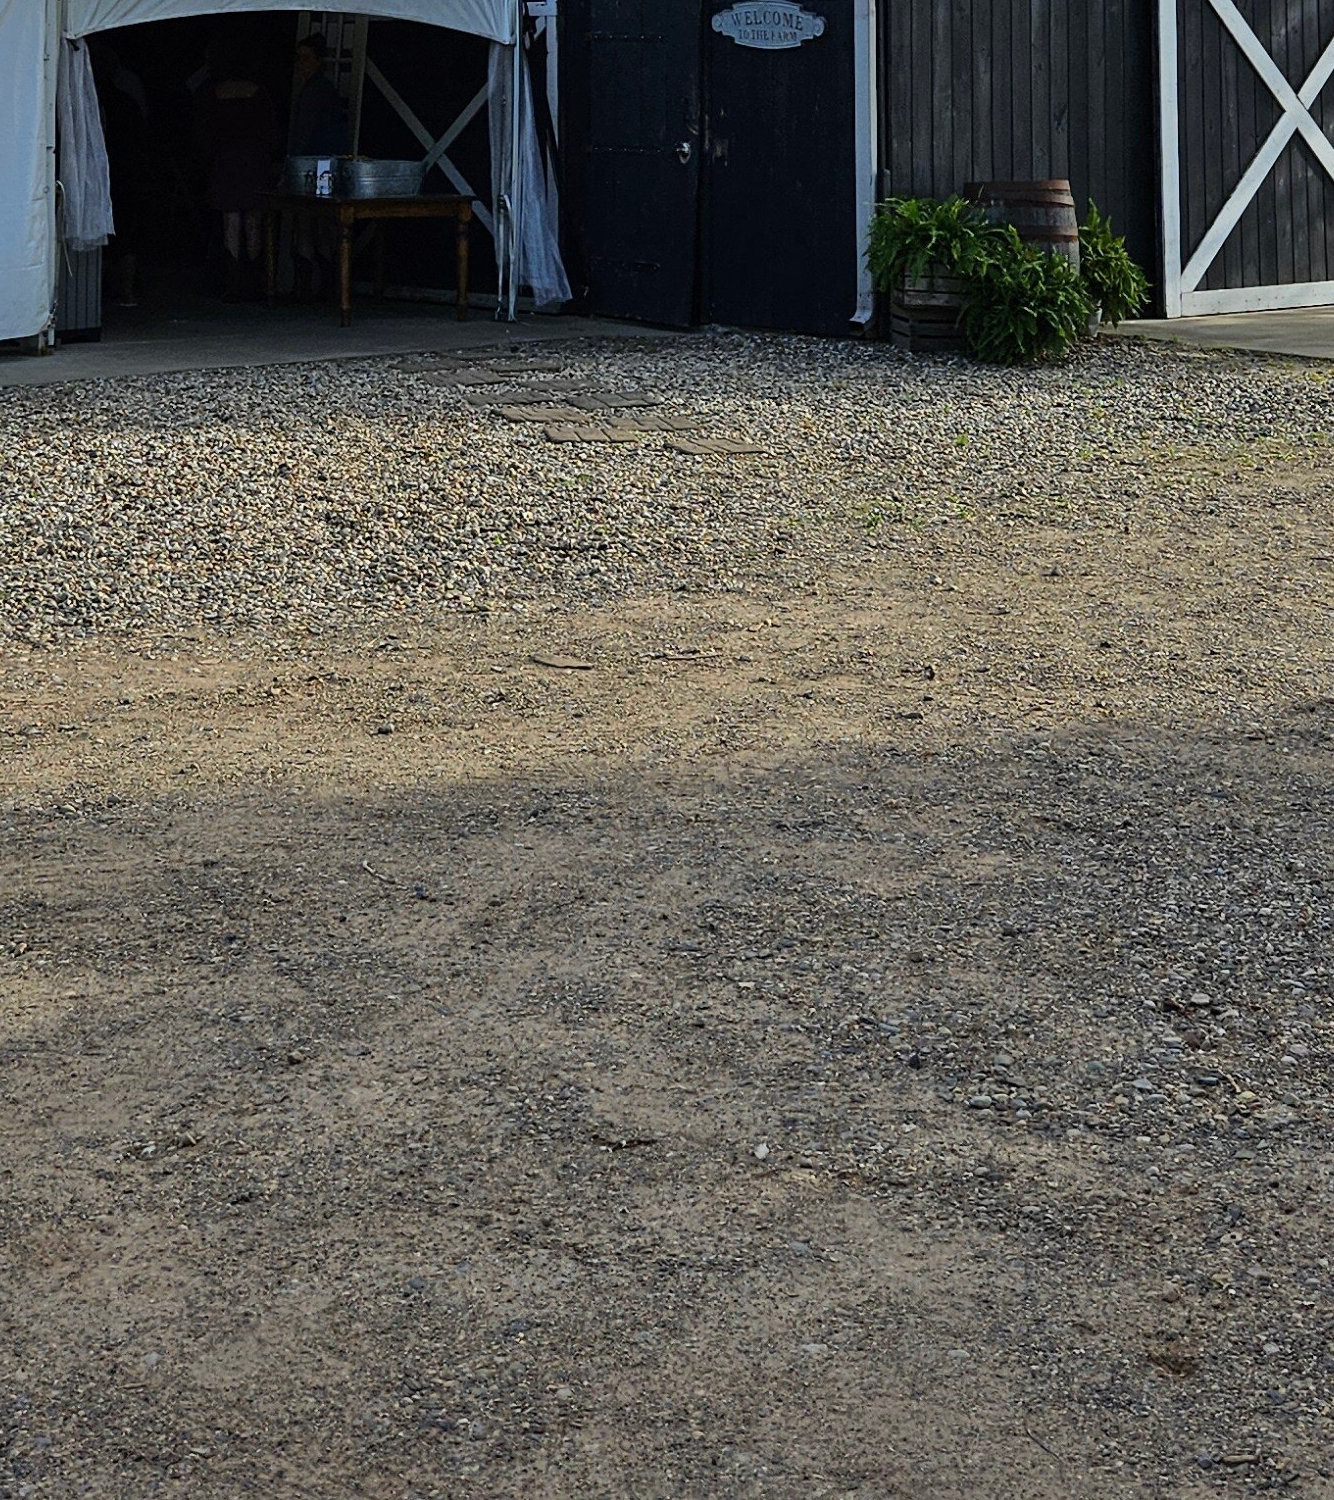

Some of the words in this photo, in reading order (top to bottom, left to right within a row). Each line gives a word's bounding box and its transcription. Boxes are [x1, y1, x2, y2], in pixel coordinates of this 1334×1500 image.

[731, 10, 803, 31] WELCOME
[739, 29, 750, 40] TO
[752, 30, 768, 40] THE
[771, 30, 798, 41] FARM
